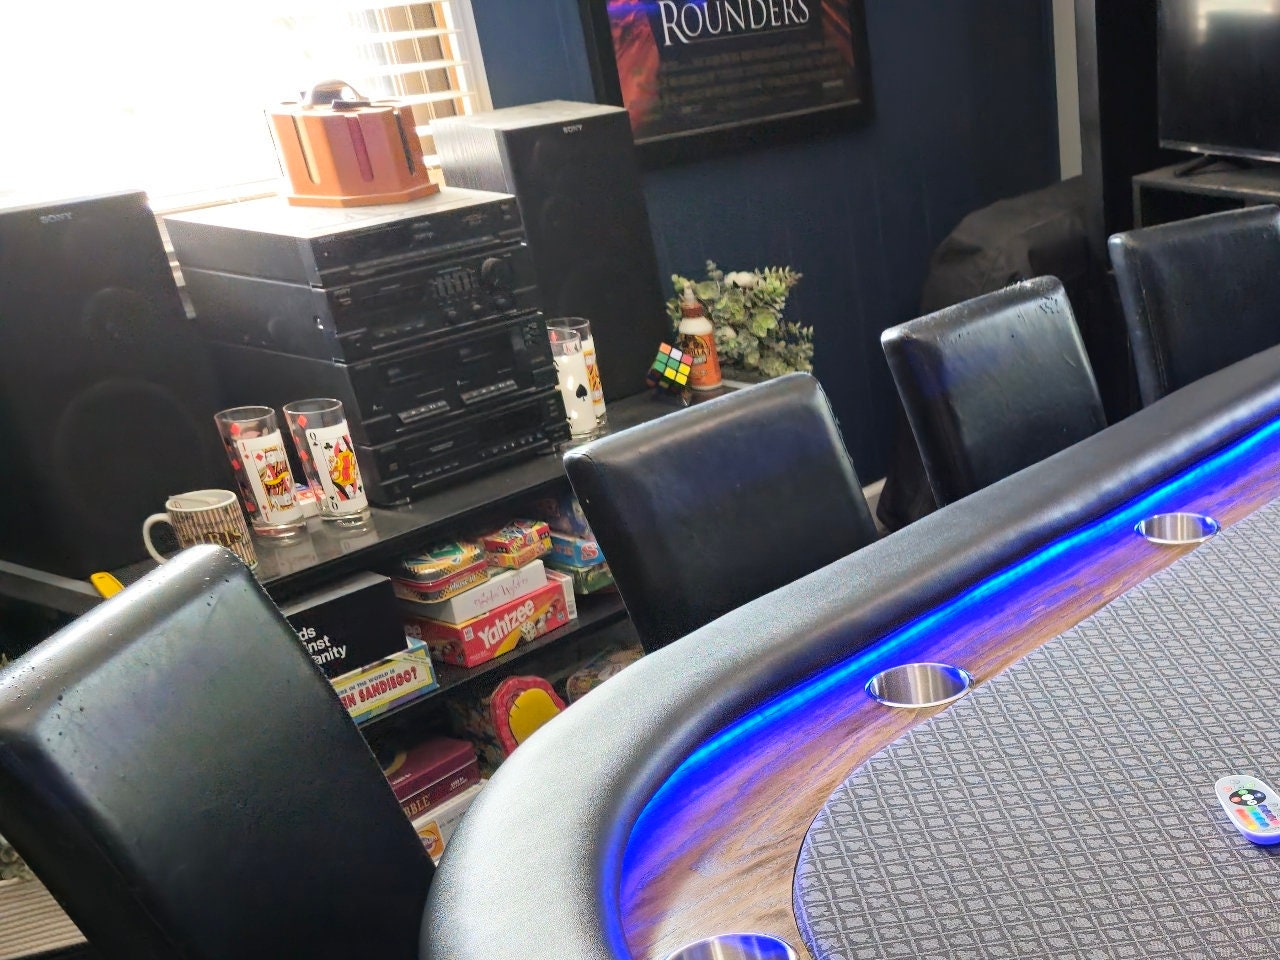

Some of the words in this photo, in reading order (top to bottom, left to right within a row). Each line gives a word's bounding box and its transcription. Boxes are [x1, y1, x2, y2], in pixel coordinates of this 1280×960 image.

[658, 0, 810, 46] ROUNDERS
[299, 626, 316, 641] ds
[477, 599, 536, 650] Yahtzee
[302, 635, 331, 653] inst
[312, 644, 347, 665] anity
[367, 671, 389, 684] WORLD
